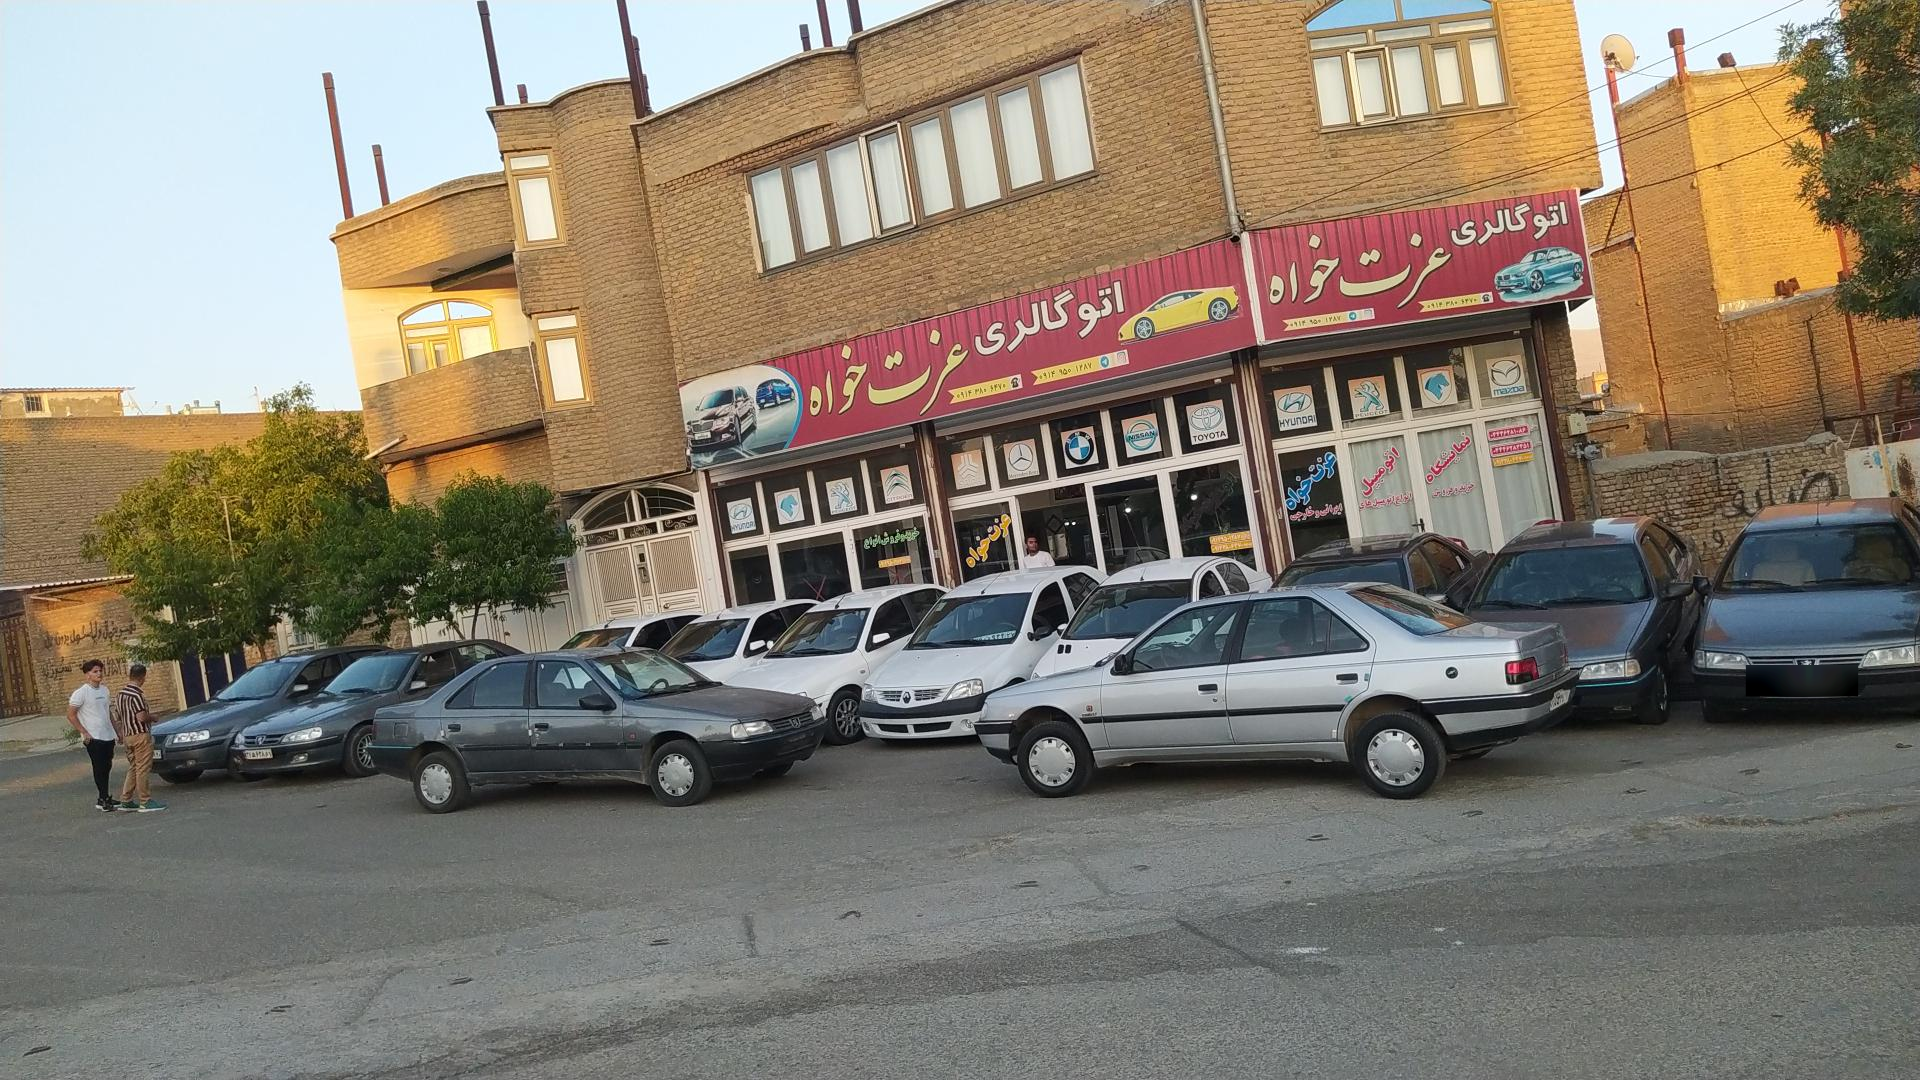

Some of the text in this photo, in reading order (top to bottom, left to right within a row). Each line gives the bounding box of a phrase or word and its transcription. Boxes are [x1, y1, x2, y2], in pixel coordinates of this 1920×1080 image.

[1449, 201, 1569, 247] اتو گالری
[1268, 231, 1452, 309] عزت خواه
[974, 280, 1125, 356] اتو گالری
[808, 328, 970, 418] عزت خواه
[1279, 413, 1317, 428] HYUNDAI
[1354, 409, 1390, 419] PEUGEOT
[1127, 430, 1157, 442] NISSAN
[1192, 429, 1227, 442] TOYOTA
[1285, 451, 1337, 510] عزت خواه
[1289, 506, 1315, 522] خارجی
[1320, 502, 1343, 516] ایرانی
[905, 526, 920, 542] خرید
[966, 512, 1011, 569] عزت خواه
